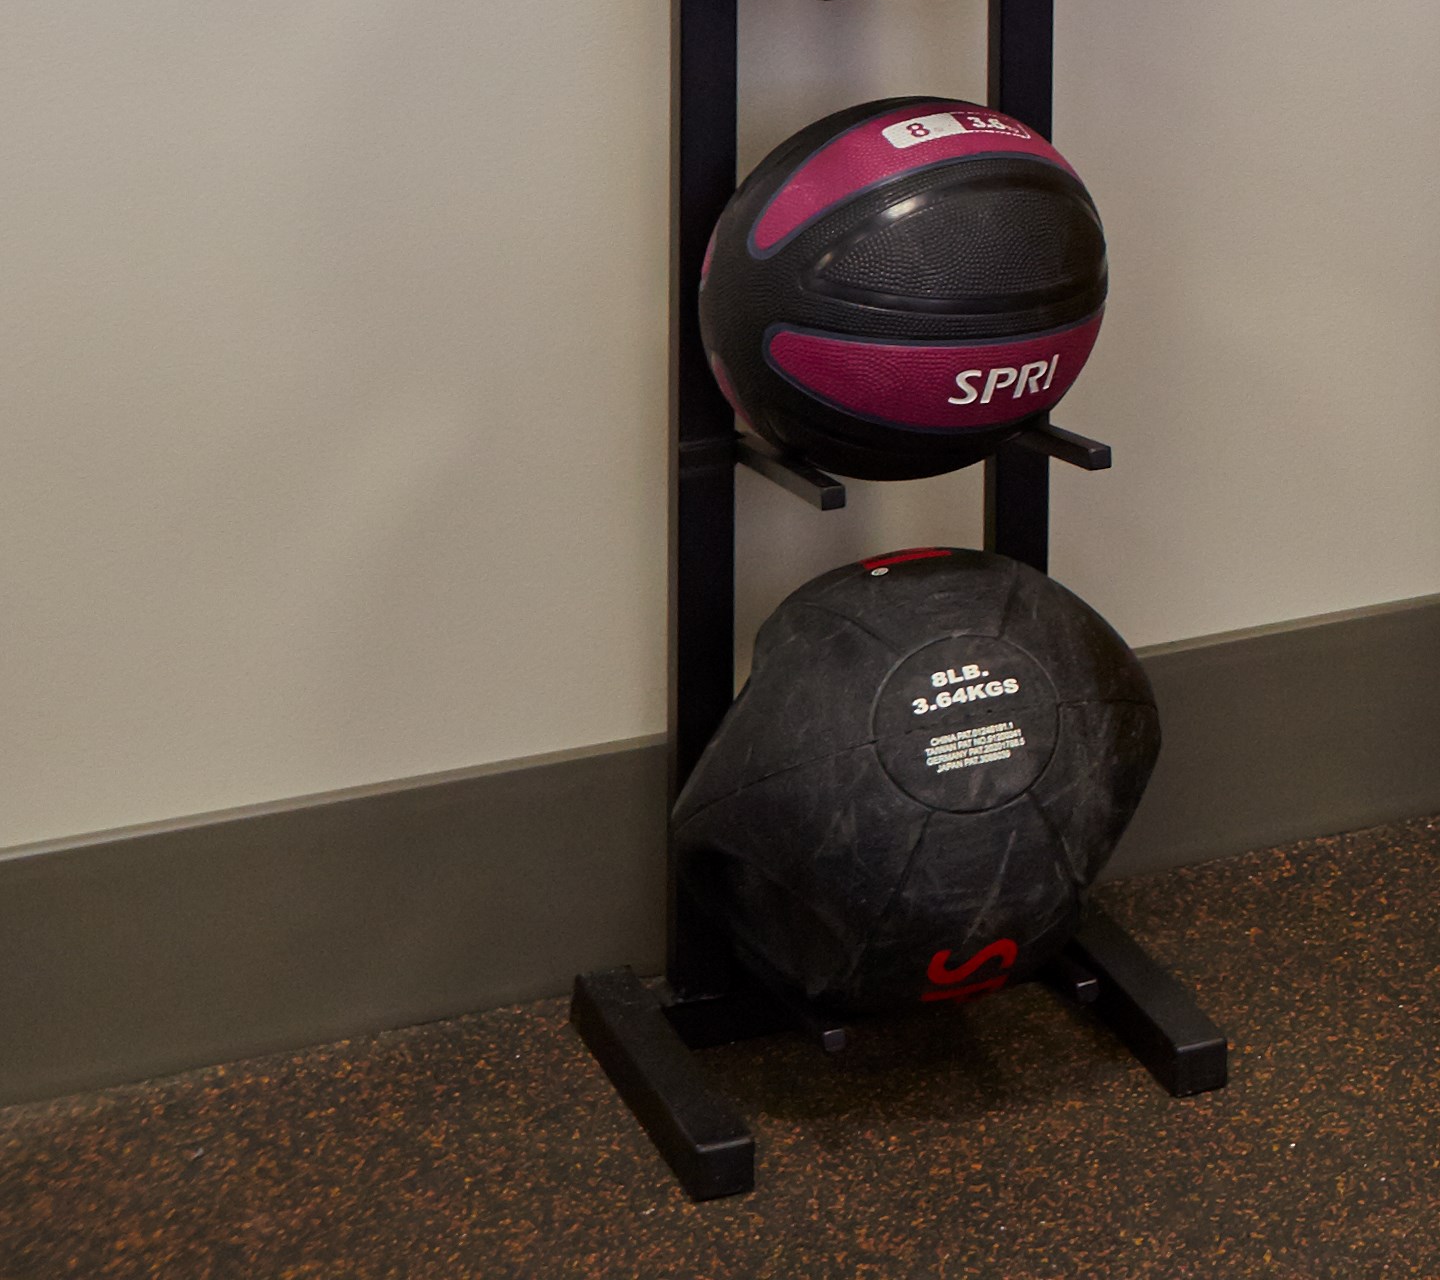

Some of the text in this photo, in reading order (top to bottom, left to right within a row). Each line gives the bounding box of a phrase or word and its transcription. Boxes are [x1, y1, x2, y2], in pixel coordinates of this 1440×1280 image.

[906, 122, 930, 138] 8
[947, 353, 1060, 405] SPRI
[931, 664, 989, 687] 8LB.
[911, 678, 1020, 715] 3.64KGS
